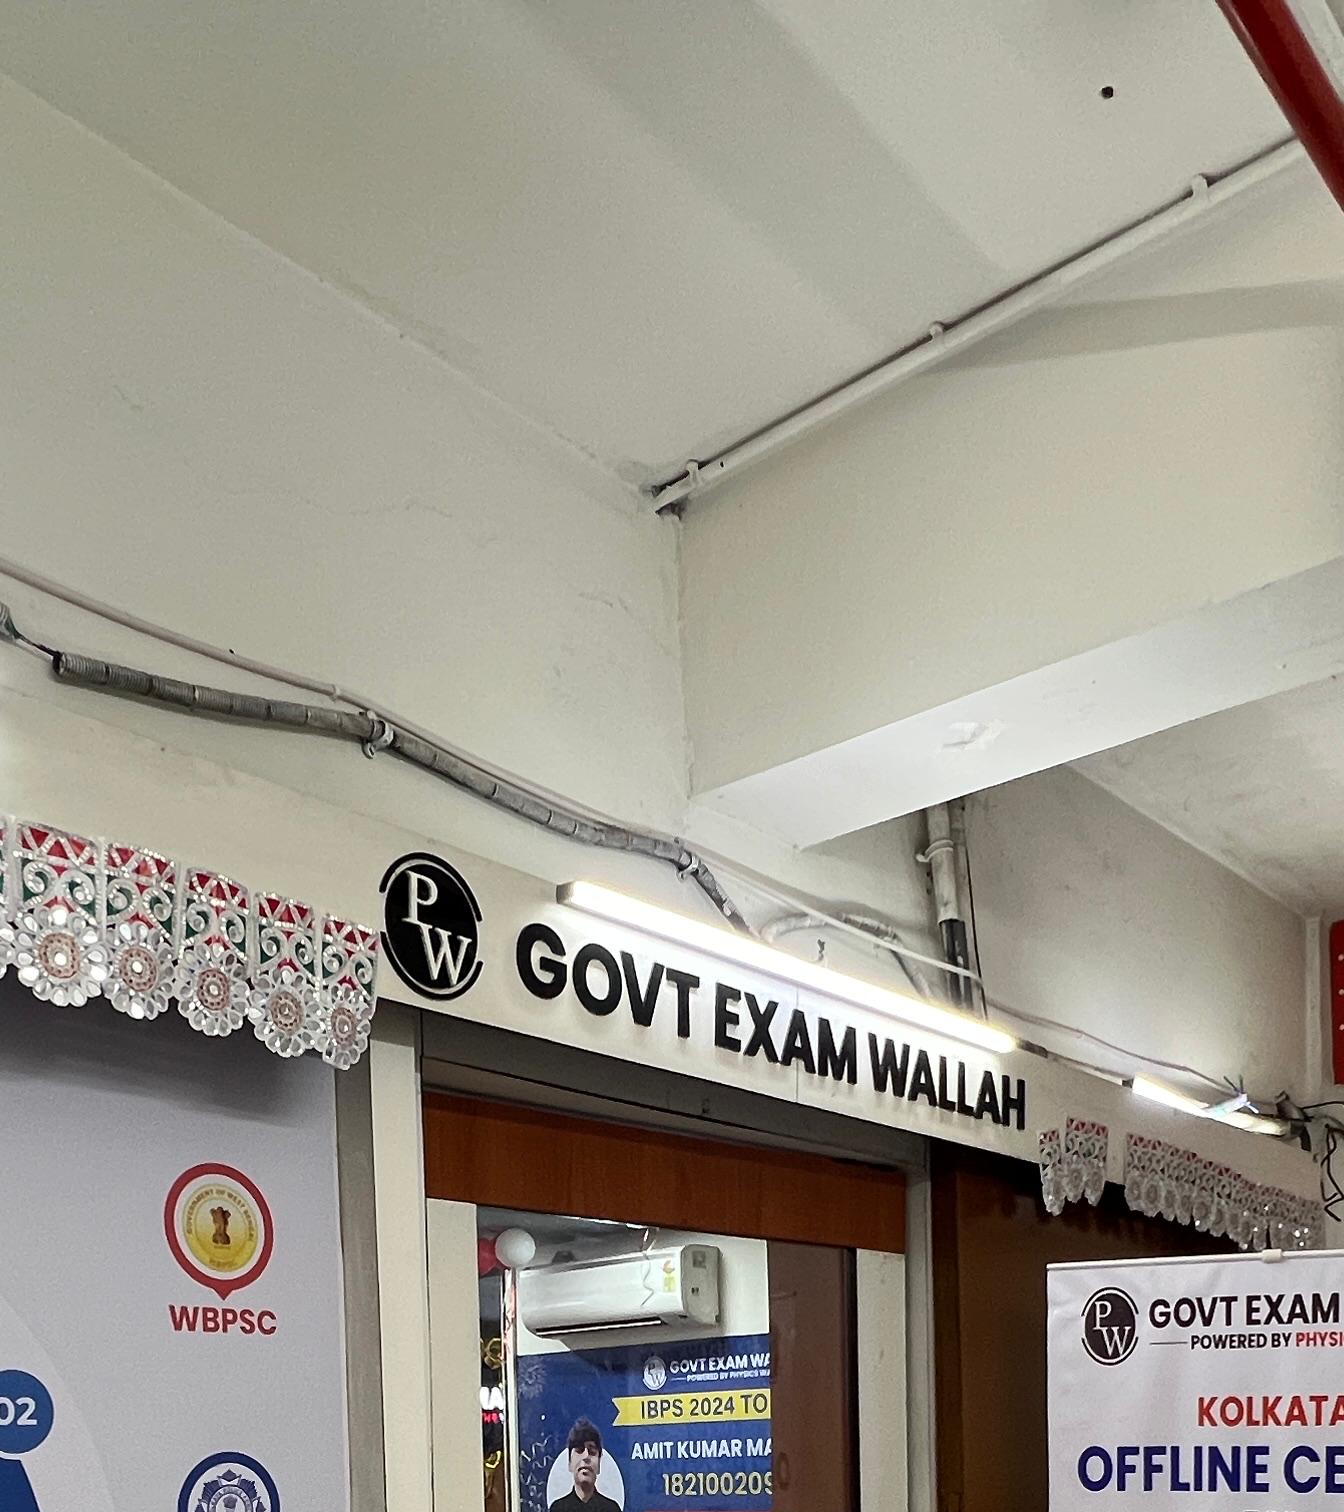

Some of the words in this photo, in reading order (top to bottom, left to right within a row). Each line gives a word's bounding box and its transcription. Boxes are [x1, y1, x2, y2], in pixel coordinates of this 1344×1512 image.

[515, 921, 701, 1040] GOVT
[713, 981, 860, 1086] EXAM
[867, 1029, 1027, 1131] WALLAH
[168, 1304, 277, 1336] WBPSC
[1148, 1295, 1239, 1330] GOVT
[1245, 1292, 1340, 1326] EXAM
[1190, 1333, 1268, 1351] POWERED
[1270, 1332, 1293, 1349] BY
[669, 1358, 706, 1375] GOVT
[708, 1355, 748, 1371] EXAM
[640, 1399, 684, 1421] IBPS
[689, 1395, 735, 1417] 2024
[740, 1392, 769, 1414] TO
[631, 1441, 675, 1460] AMIT
[677, 1438, 743, 1460] KUMAR
[1077, 1444, 1271, 1494] OFFLINE
